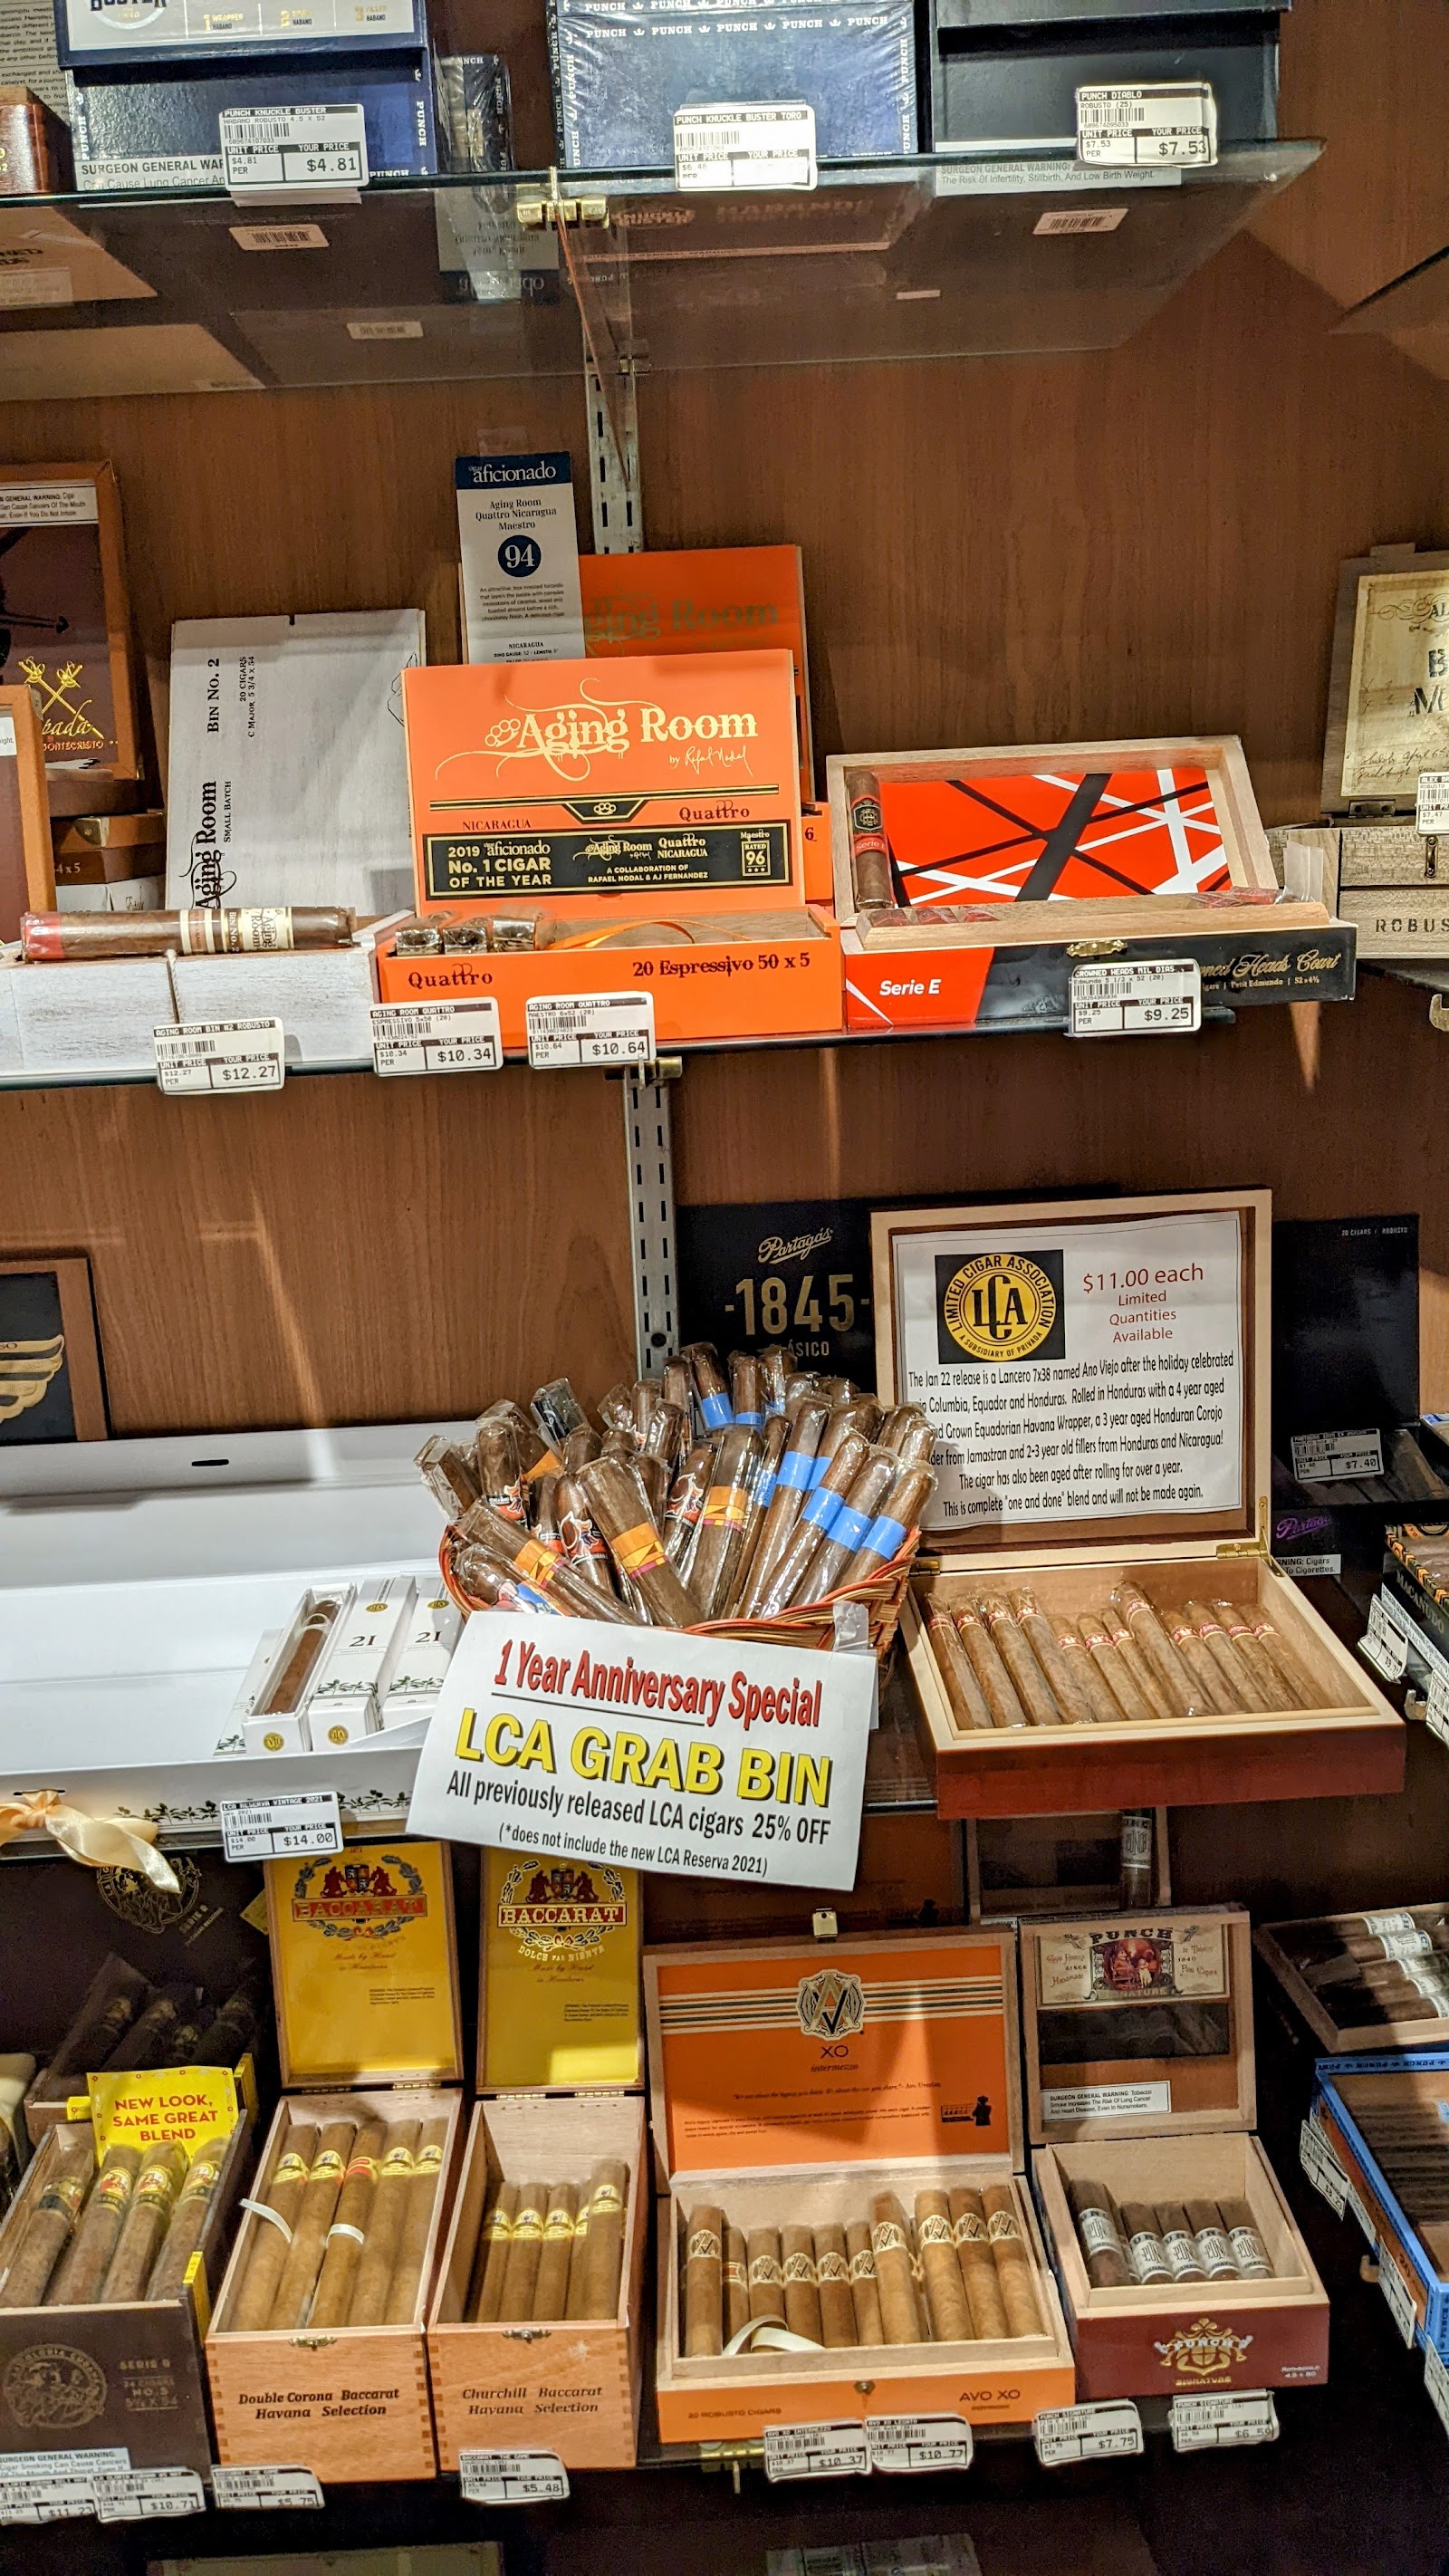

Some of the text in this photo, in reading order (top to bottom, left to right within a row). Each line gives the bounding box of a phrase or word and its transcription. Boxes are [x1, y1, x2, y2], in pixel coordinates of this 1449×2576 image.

[587, 23, 757, 37] PUNCH PUNCH PUNCH
[1111, 91, 1142, 99] DIABLO
[676, 111, 801, 124] PUNCH KNUCKLE BUSTER TORO
[1159, 140, 1206, 156] $7.53
[307, 158, 356, 172] $4.81
[941, 162, 1070, 175] SURGEON GENERAL WARNING:
[942, 177, 956, 185] The
[959, 176, 976, 184] Risk
[1065, 172, 1081, 180] And
[1084, 171, 1100, 179] Low
[1103, 170, 1121, 179] Birth
[474, 461, 556, 483] aficionado
[490, 501, 513, 510] Aging
[475, 508, 557, 521] Quattro Nicaragua
[499, 522, 535, 530] Maestro
[505, 544, 535, 568] 94
[640, 708, 759, 742] Room
[196, 781, 216, 844] Room
[463, 800, 750, 831] NICARAGUA Quattro
[658, 833, 705, 848] Quattro
[448, 841, 551, 858] 2019 aficionado
[657, 849, 707, 860] NICARAGUA
[746, 851, 765, 865] 96
[449, 859, 551, 874] No. 1 CIGAR
[614, 865, 676, 873] COLLABORATION
[449, 874, 552, 889] OF THE YEAR
[664, 871, 708, 879] FERNANDEZ
[633, 952, 810, 978] 20 Espressivo 50 x 5
[408, 963, 493, 988] Quattro
[879, 979, 940, 995] Serie E
[1145, 1008, 1189, 1023] $9.25
[238, 1022, 270, 1030] ROBUSTO
[438, 1048, 492, 1062] $10.34
[592, 1042, 646, 1055] $10.64
[223, 1066, 275, 1081] $12.27
[1083, 1263, 1204, 1293] $11.00 each
[945, 1255, 1055, 1331] LIMITED CIGAR ASSOCIATION
[1118, 1290, 1166, 1306] Limited
[1109, 1310, 1176, 1325] Quantities
[1113, 1327, 1173, 1343] Available
[964, 1339, 1003, 1357] SUBSIDIARY
[1007, 1348, 1015, 1356] OF
[1017, 1331, 1042, 1353] PRIVADA
[908, 1350, 1233, 1388] The Jan 22 release is a Lancero 7x38 named Ano Viejo after the holiday celebrated
[1346, 1459, 1377, 1469] $7.40
[494, 1639, 822, 1732] 1 Year Anniversary Special
[456, 1706, 834, 1809] LCA GRAB BIN
[446, 1769, 831, 1846] All previously released LCA cigars 25% OFF
[284, 1832, 332, 1847] $14.00
[541, 1830, 562, 1848] not
[564, 1831, 607, 1856] include
[609, 1841, 629, 1860] the
[631, 1846, 654, 1863] new
[657, 1846, 680, 1865] LCA
[683, 1852, 729, 1872] Reserva
[732, 1854, 769, 1878] 2021)
[298, 1898, 425, 1918] BACCARAT
[503, 1908, 619, 1924] BACCARAT
[1089, 1927, 1173, 1944] PUNCH
[820, 2045, 849, 2058] XO
[115, 2094, 213, 2110] NEW LOOK,
[113, 2110, 218, 2127] SAME GREAT
[140, 2129, 196, 2141] BLEND
[1172, 2337, 1232, 2350] PUNCH
[239, 2389, 399, 2405] Double Corona Baccarat
[463, 2386, 602, 2399] Churchill Baccarat
[960, 2389, 1021, 2401] AVO XO
[255, 2404, 387, 2419] Havana Selection
[468, 2402, 599, 2415] Havana Selection
[523, 2484, 561, 2494] $5.48
[151, 2501, 197, 2510] $10.71
